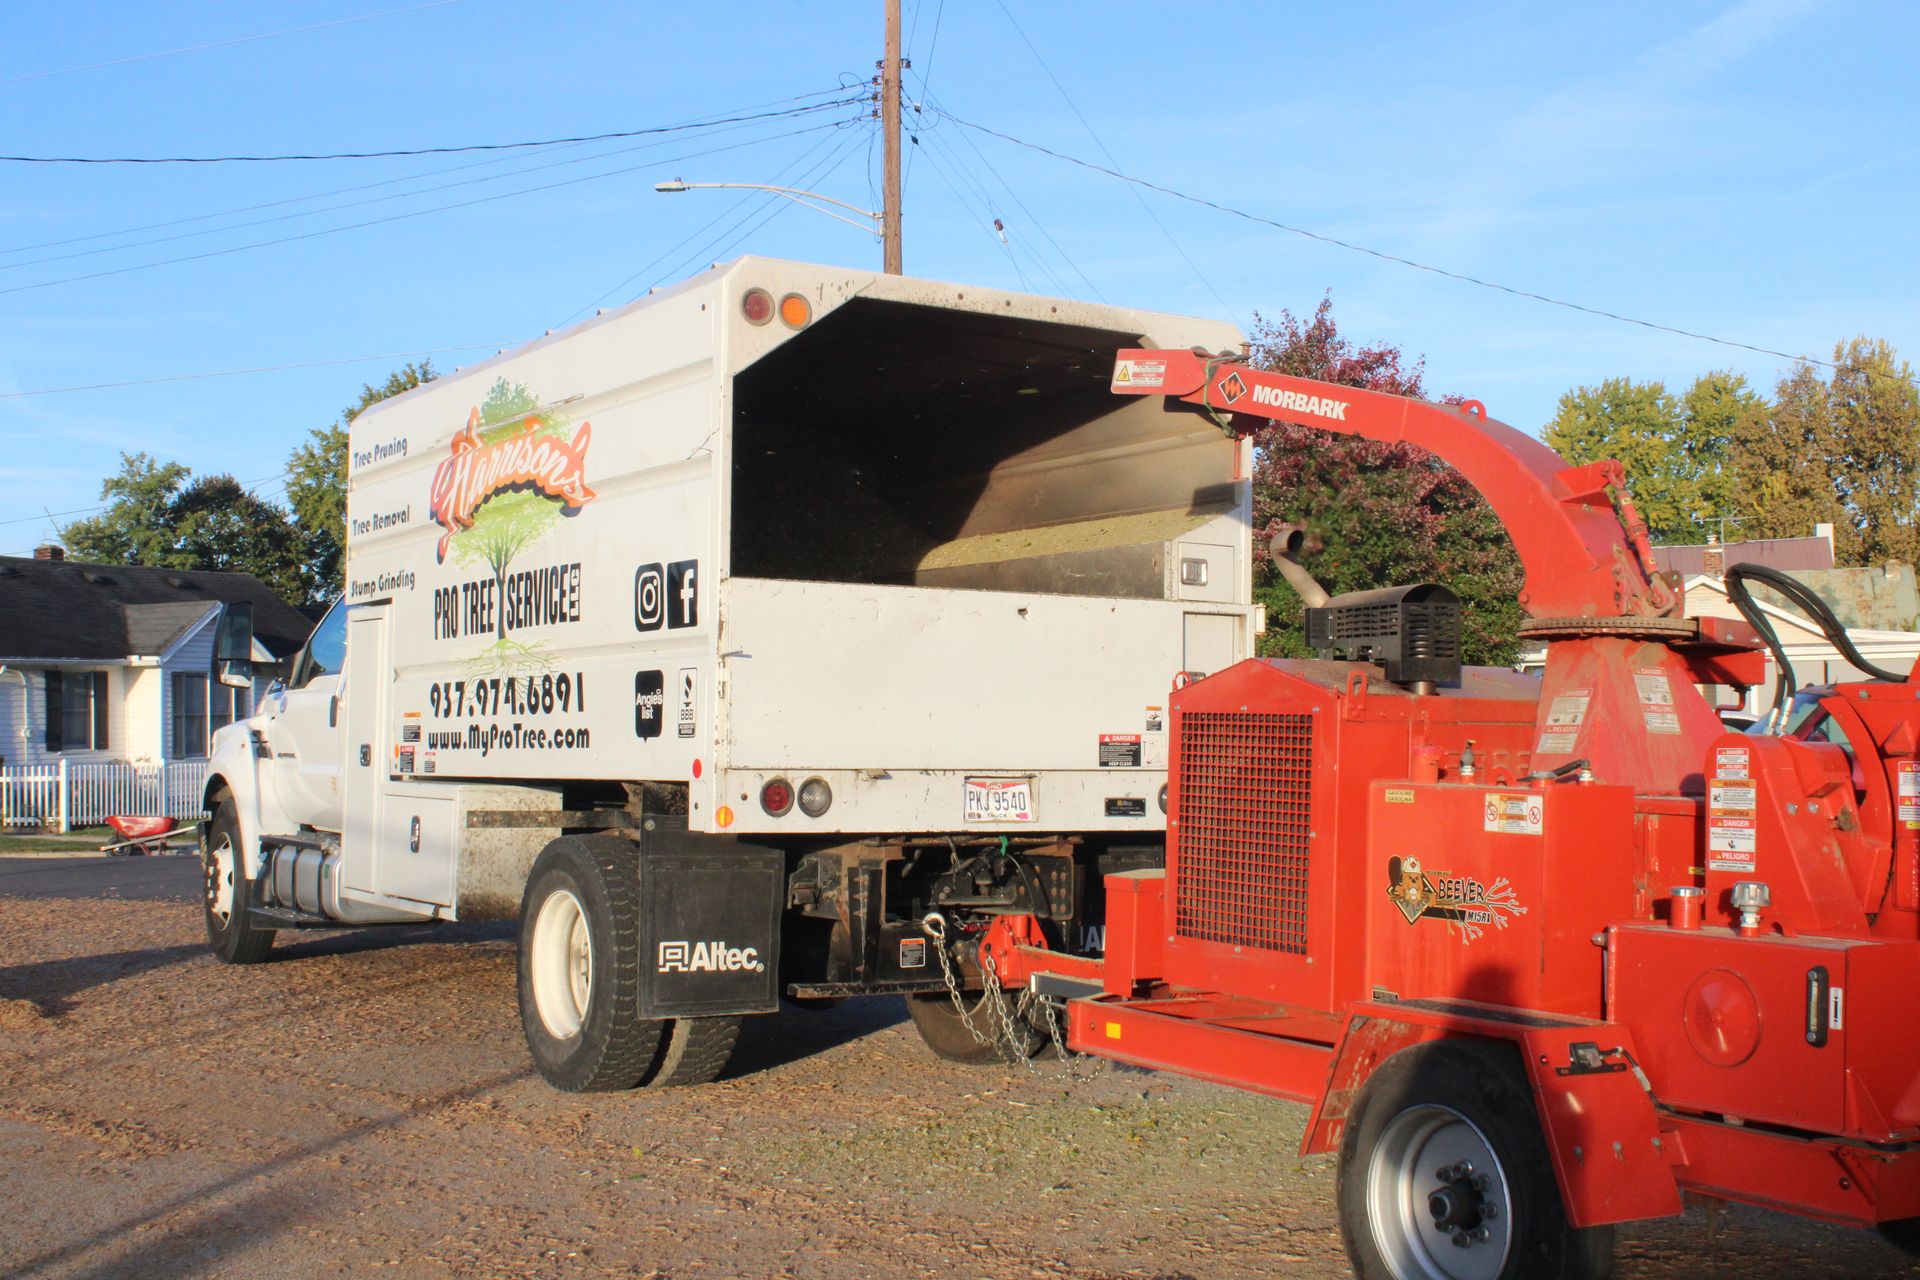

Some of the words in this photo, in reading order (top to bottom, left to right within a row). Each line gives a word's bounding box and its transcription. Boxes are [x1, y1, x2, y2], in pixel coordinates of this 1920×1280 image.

[1252, 384, 1347, 421] MORBARK
[353, 451, 372, 469] Tree
[374, 437, 408, 462] Pruning
[352, 519, 371, 536] Tree
[373, 504, 410, 532] Removal
[351, 578, 376, 598] Stump
[378, 569, 415, 592] Grinding
[434, 584, 459, 640] PRO
[462, 578, 495, 636] TREE
[506, 563, 569, 631] SERVICE
[430, 672, 585, 718] 937.974.6891
[641, 705, 654, 719] list
[428, 723, 590, 758] www.MyProTree.com
[968, 790, 990, 811] PKJ
[993, 791, 1026, 811] 9540
[1723, 819, 1749, 827] DANGER
[1722, 852, 1749, 861] PELIGRO
[1438, 877, 1485, 903] BEEVER
[689, 941, 758, 972] Altec
